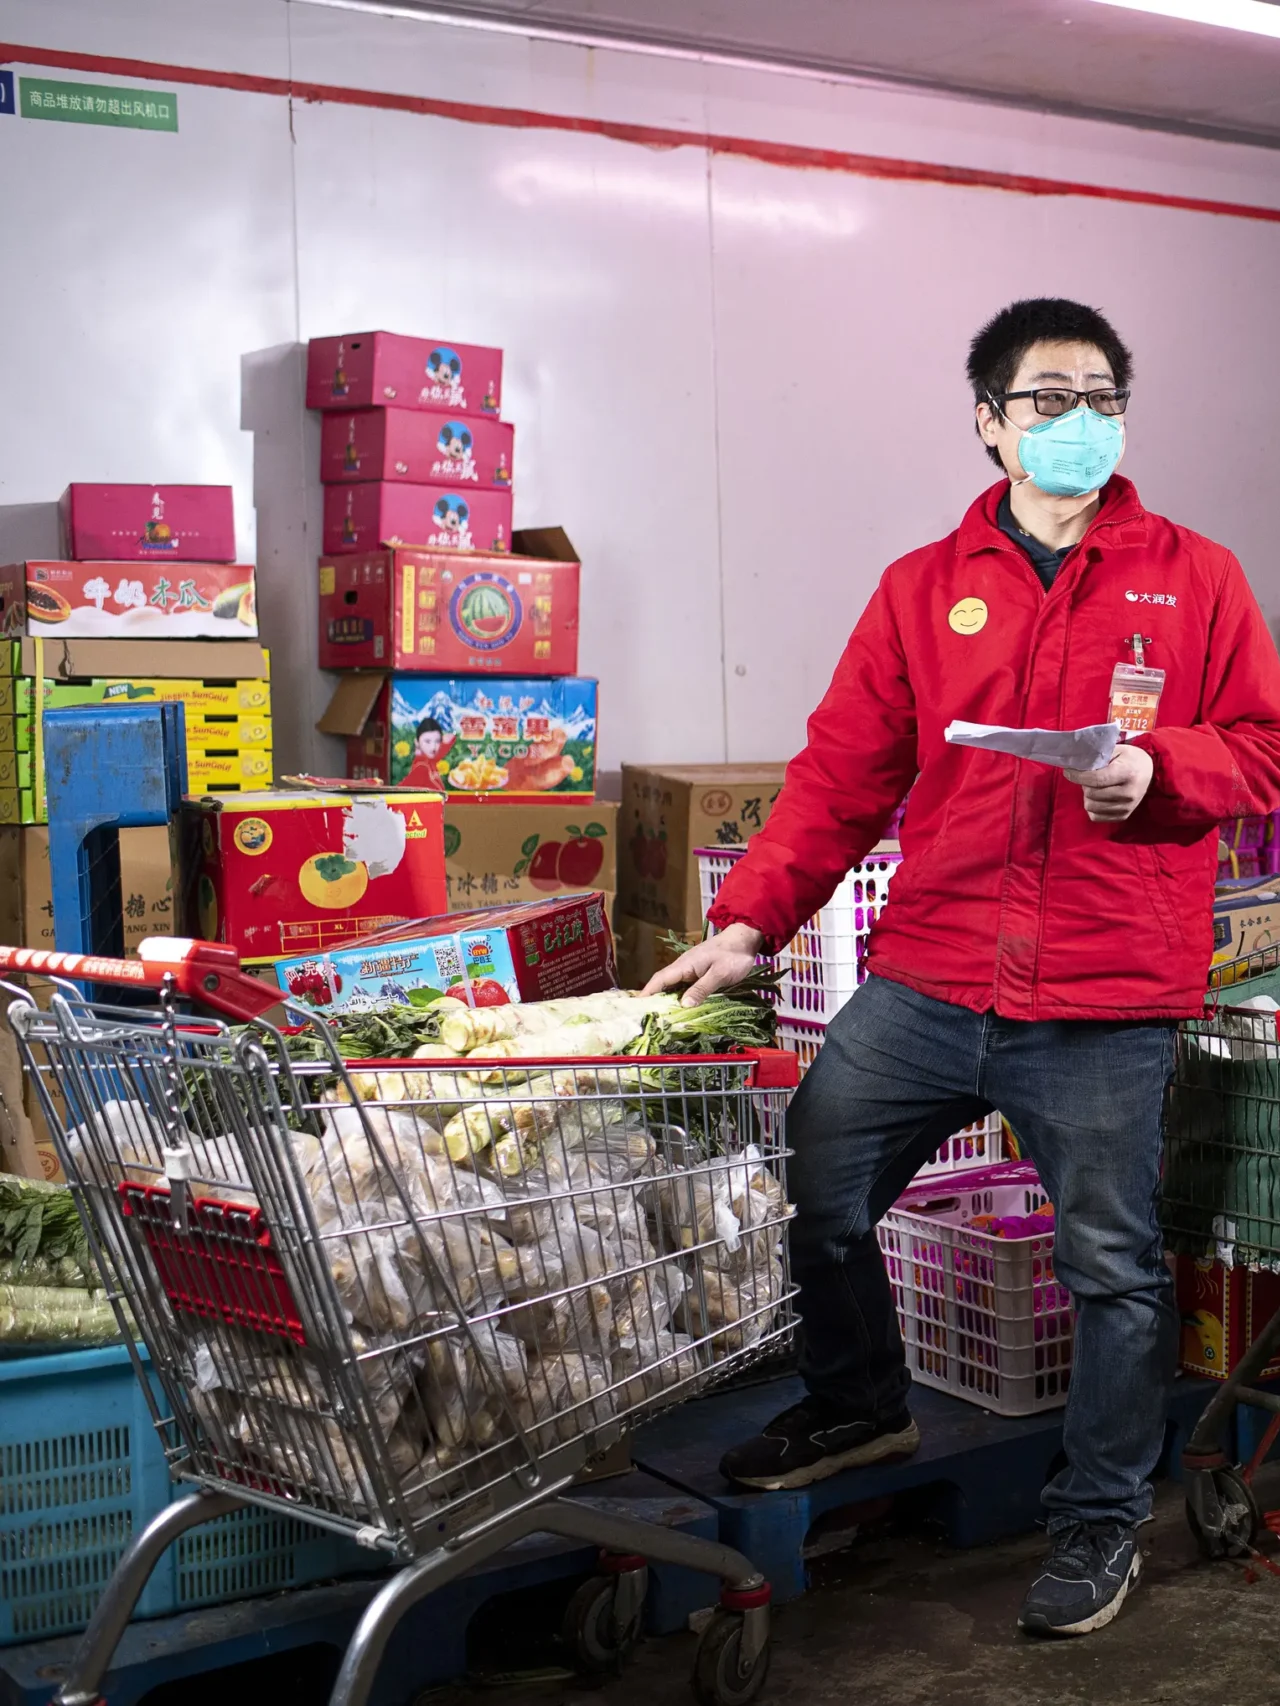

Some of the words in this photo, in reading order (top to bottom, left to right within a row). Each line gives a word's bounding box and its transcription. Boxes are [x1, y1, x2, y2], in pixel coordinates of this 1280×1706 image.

[29, 90, 170, 119] 商品堆放请勿超出风机口
[1139, 592, 1177, 608] 大润发
[108, 684, 129, 697] NEW
[191, 689, 229, 704] SunGold
[193, 726, 230, 739] SunGold
[466, 743, 544, 759] YACON
[195, 759, 232, 772] SunGold
[152, 923, 171, 932] XIN
